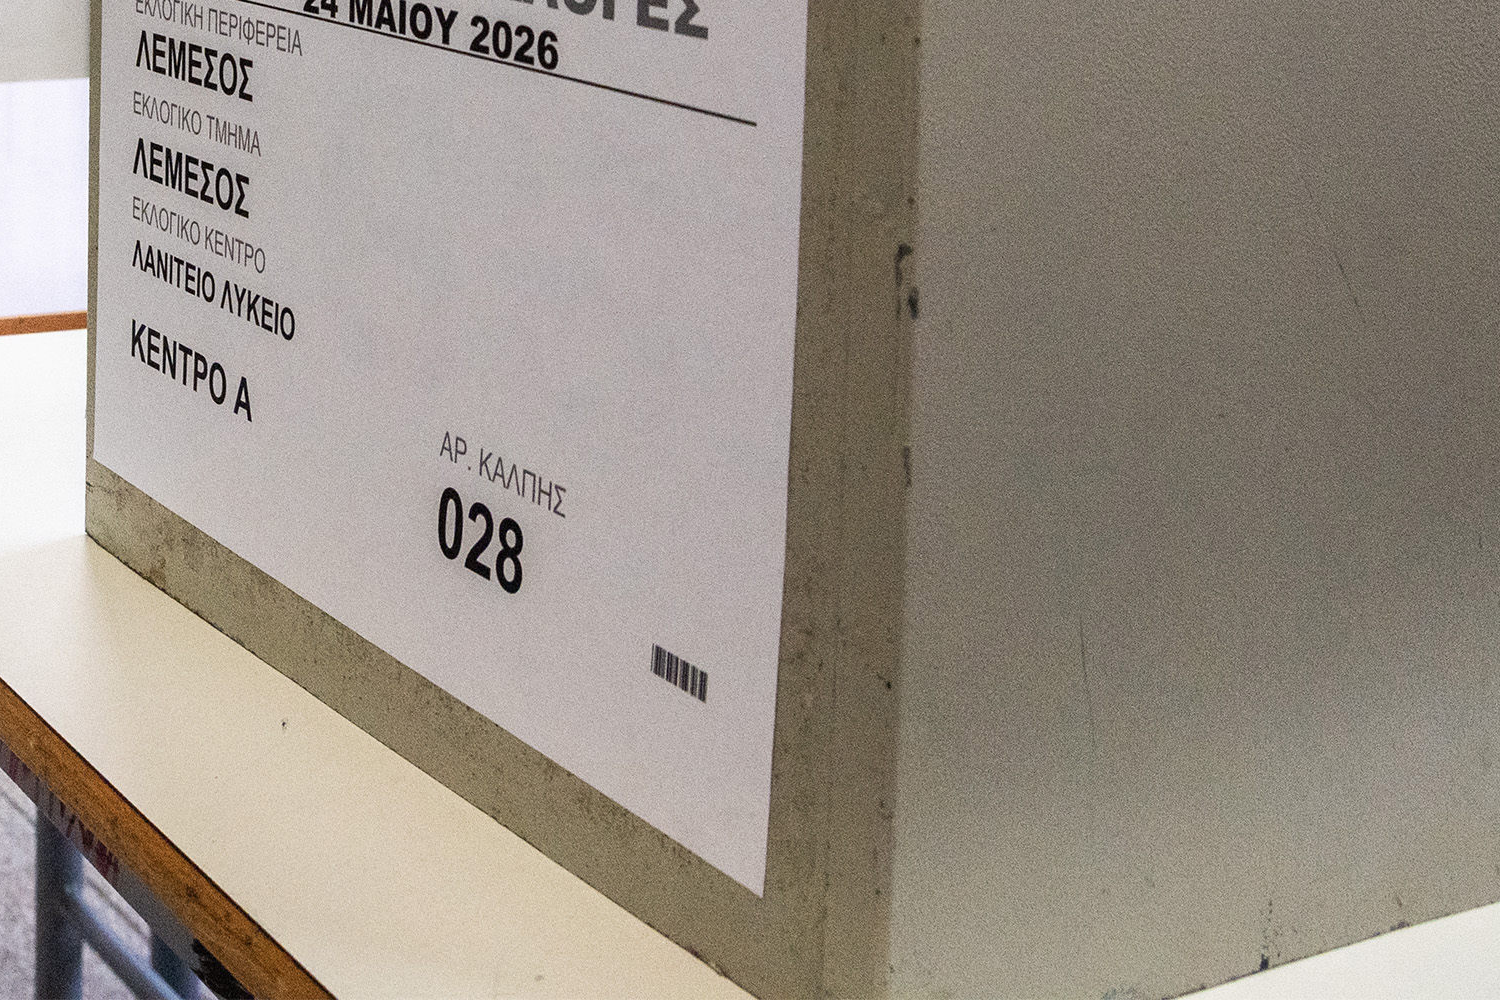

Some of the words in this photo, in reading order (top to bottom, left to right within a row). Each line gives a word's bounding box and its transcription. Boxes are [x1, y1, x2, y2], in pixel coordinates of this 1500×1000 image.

[135, 29, 254, 103] ΛΕΜΕΣΟΣ
[208, 7, 303, 57] ΠΕΡΙΦΕΡΕΙΑ
[469, 15, 559, 70] 2026
[133, 90, 202, 136] ΕΚΛΟΓΙΚΟ
[206, 114, 262, 157] ΤΜΗΜΑ
[132, 136, 251, 220] ΛΕΜΕΣΟΣ
[132, 196, 201, 246] ΕΚΛΟΓΙΚΟ
[204, 225, 267, 275] ΚΕΝΤΡΟ
[131, 239, 217, 304] ΛΑΝΙΤΕΙΟ
[220, 279, 296, 342] ΛΥΚΕΙΟ
[130, 318, 228, 406] ΚΕΝΤΡΟ
[232, 375, 253, 423] Α
[439, 430, 472, 472] ΑΡ.
[478, 447, 568, 519] ΚΑΛΠΗΣ
[437, 486, 525, 596] 028
